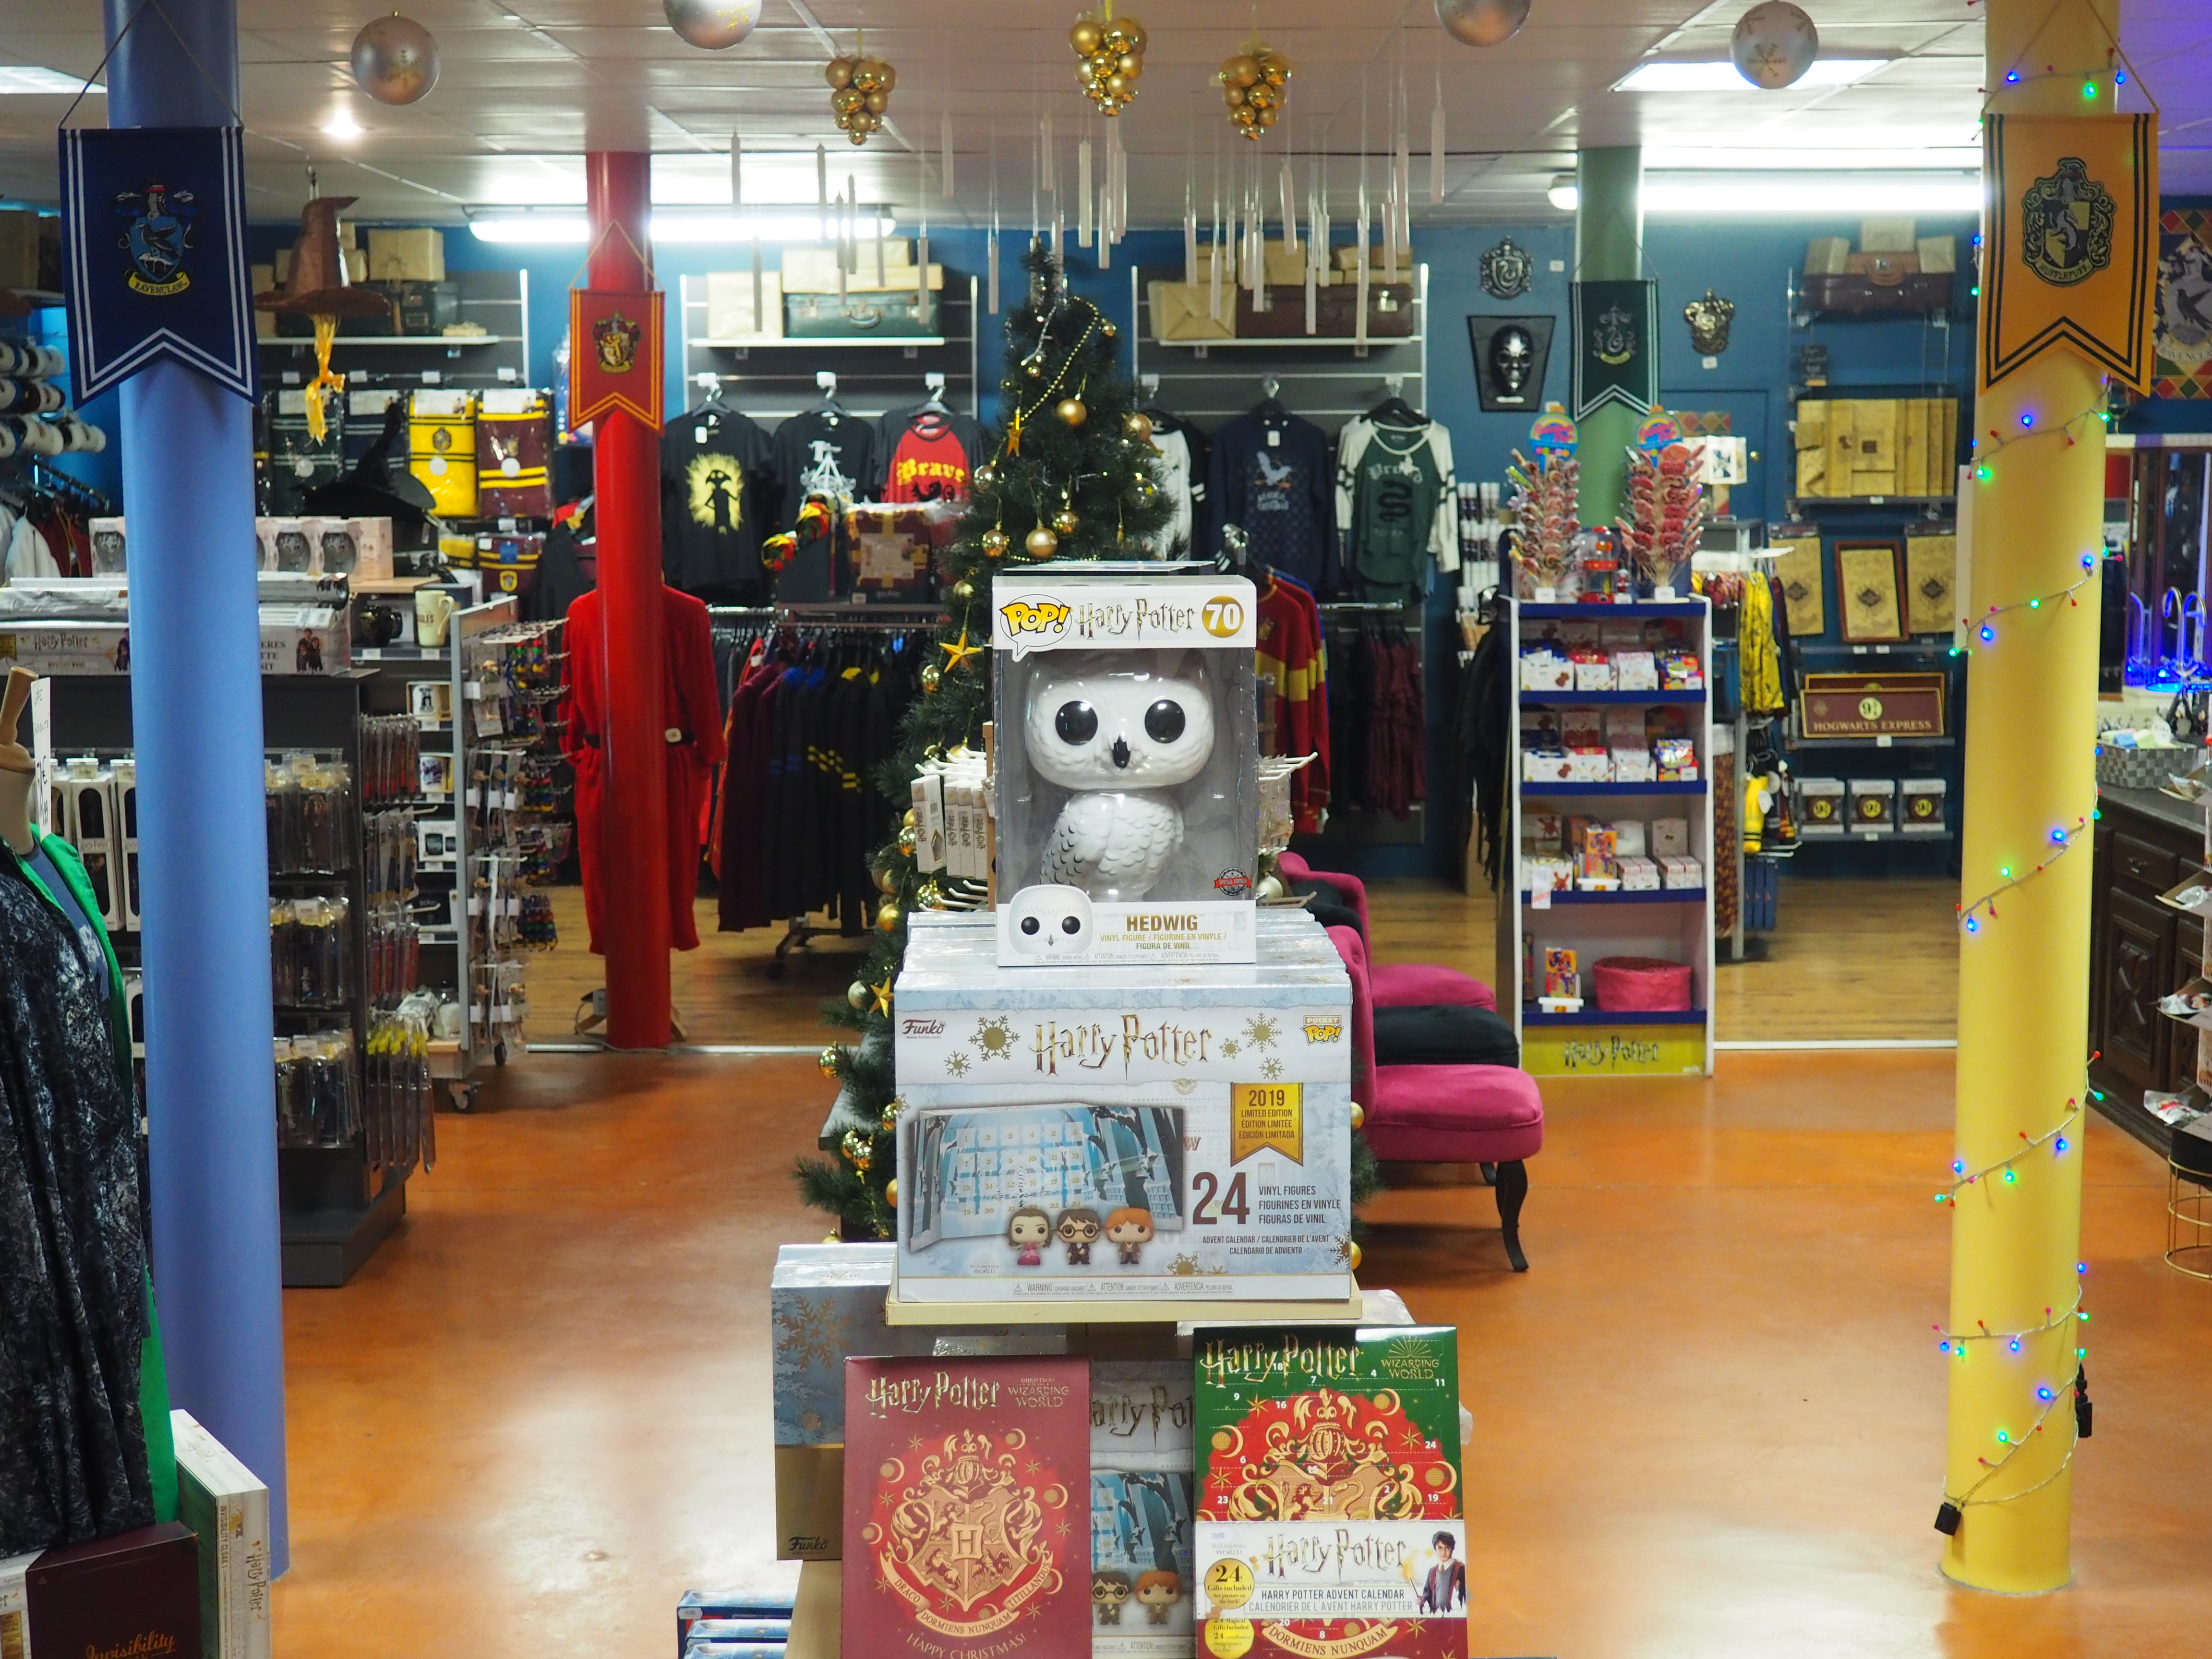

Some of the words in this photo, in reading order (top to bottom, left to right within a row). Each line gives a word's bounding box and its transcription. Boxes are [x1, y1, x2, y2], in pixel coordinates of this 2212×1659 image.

[2039, 263, 2089, 279] HUFFLEPUFF
[896, 458, 965, 486] Brave
[999, 602, 1071, 637] POP!
[1075, 602, 1133, 640] Harry
[1134, 598, 1196, 642] Potter
[1205, 604, 1241, 630] 70
[1813, 721, 1877, 732] HOGWARTS
[1881, 720, 1932, 731] EXPRESS
[1127, 914, 1198, 932] HEDWIG
[902, 1019, 946, 1034] Funko
[1302, 1024, 1342, 1044] POP!
[1028, 1021, 1118, 1076] Harry
[1120, 1014, 1213, 1081] Potter
[1563, 1039, 1609, 1070] Harry
[1610, 1035, 1659, 1070] Potter
[1249, 1089, 1285, 1106] 2019
[1241, 1109, 1266, 1118] LIMITED
[1268, 1109, 1292, 1117] EDITION
[1267, 1118, 1292, 1128] LIMITÉE
[1265, 1130, 1295, 1139] LIMITADA
[1259, 1186, 1282, 1195] VINYL
[1284, 1185, 1316, 1195] FIGURES
[1192, 1171, 1250, 1225] 24
[1259, 1200, 1299, 1210] FIGURINES
[1301, 1200, 1311, 1209] EN
[1313, 1199, 1341, 1209] VINYLE
[1259, 1214, 1291, 1224] FIGURAS
[1294, 1214, 1304, 1224] DE
[1305, 1214, 1326, 1224] VINIL
[1202, 1236, 1224, 1244] ADVENT
[1226, 1235, 1255, 1243] CALENDAR
[1262, 1235, 1296, 1243] CALENDRIER
[1298, 1235, 1305, 1243] DE
[1306, 1235, 1329, 1243] L'AVENT
[1229, 1247, 1264, 1255] CALENDARIO
[1274, 1246, 1302, 1254] ADVIENTO
[1027, 1283, 1054, 1292] WARNING:
[1200, 1339, 1278, 1388] Harry
[1283, 1334, 1362, 1380] Potter
[1273, 1362, 1283, 1371] 18
[1381, 1358, 1439, 1370] WIZARDING
[1370, 1369, 1377, 1377] 4
[1389, 1369, 1434, 1379] WORLD
[1310, 1376, 1317, 1384] 7
[1435, 1379, 1445, 1387] 11
[866, 1377, 932, 1419] Harry
[933, 1371, 1000, 1410] Potter
[1008, 1386, 1070, 1397] WIZARDING
[1234, 1393, 1240, 1401] 9
[1016, 1396, 1063, 1407] WORLD
[1275, 1401, 1287, 1409] 16
[1090, 1394, 1147, 1437] arry
[1425, 1441, 1437, 1449] 24
[1384, 1485, 1390, 1493] 2
[1217, 1496, 1229, 1504] 23
[1322, 1497, 1334, 1505] 21
[1428, 1494, 1439, 1502] 19
[789, 1536, 829, 1551] Funko
[958, 1529, 975, 1555] H
[1262, 1534, 1332, 1579] Harry
[1334, 1528, 1407, 1583] Potter
[246, 1553, 263, 1579] Harry
[1215, 1564, 1242, 1583] 24
[245, 1580, 266, 1611] Potter
[894, 1577, 921, 1603] DRACO
[920, 1611, 965, 1634] DORMIENS
[968, 1611, 1012, 1634] NUNQUAM
[1006, 1562, 1052, 1607] TITILLANDUS
[1262, 1590, 1289, 1600] HARRY
[1292, 1590, 1323, 1599] POTTER
[1326, 1589, 1358, 1599] ADVENT
[1361, 1589, 1405, 1599] CALENDAR
[1249, 1601, 1299, 1612] CALENDRIER
[1301, 1601, 1311, 1611] DE
[1351, 1601, 1379, 1611] HARRY
[1381, 1601, 1412, 1611] POTTER
[1279, 1618, 1290, 1627] 20
[1319, 1630, 1326, 1639] 8
[86, 1631, 176, 1659] Invisibility
[907, 1633, 946, 1658] HAPPY
[1268, 1626, 1326, 1656] DORMIENS
[1331, 1628, 1388, 1656] NUNQUAM
